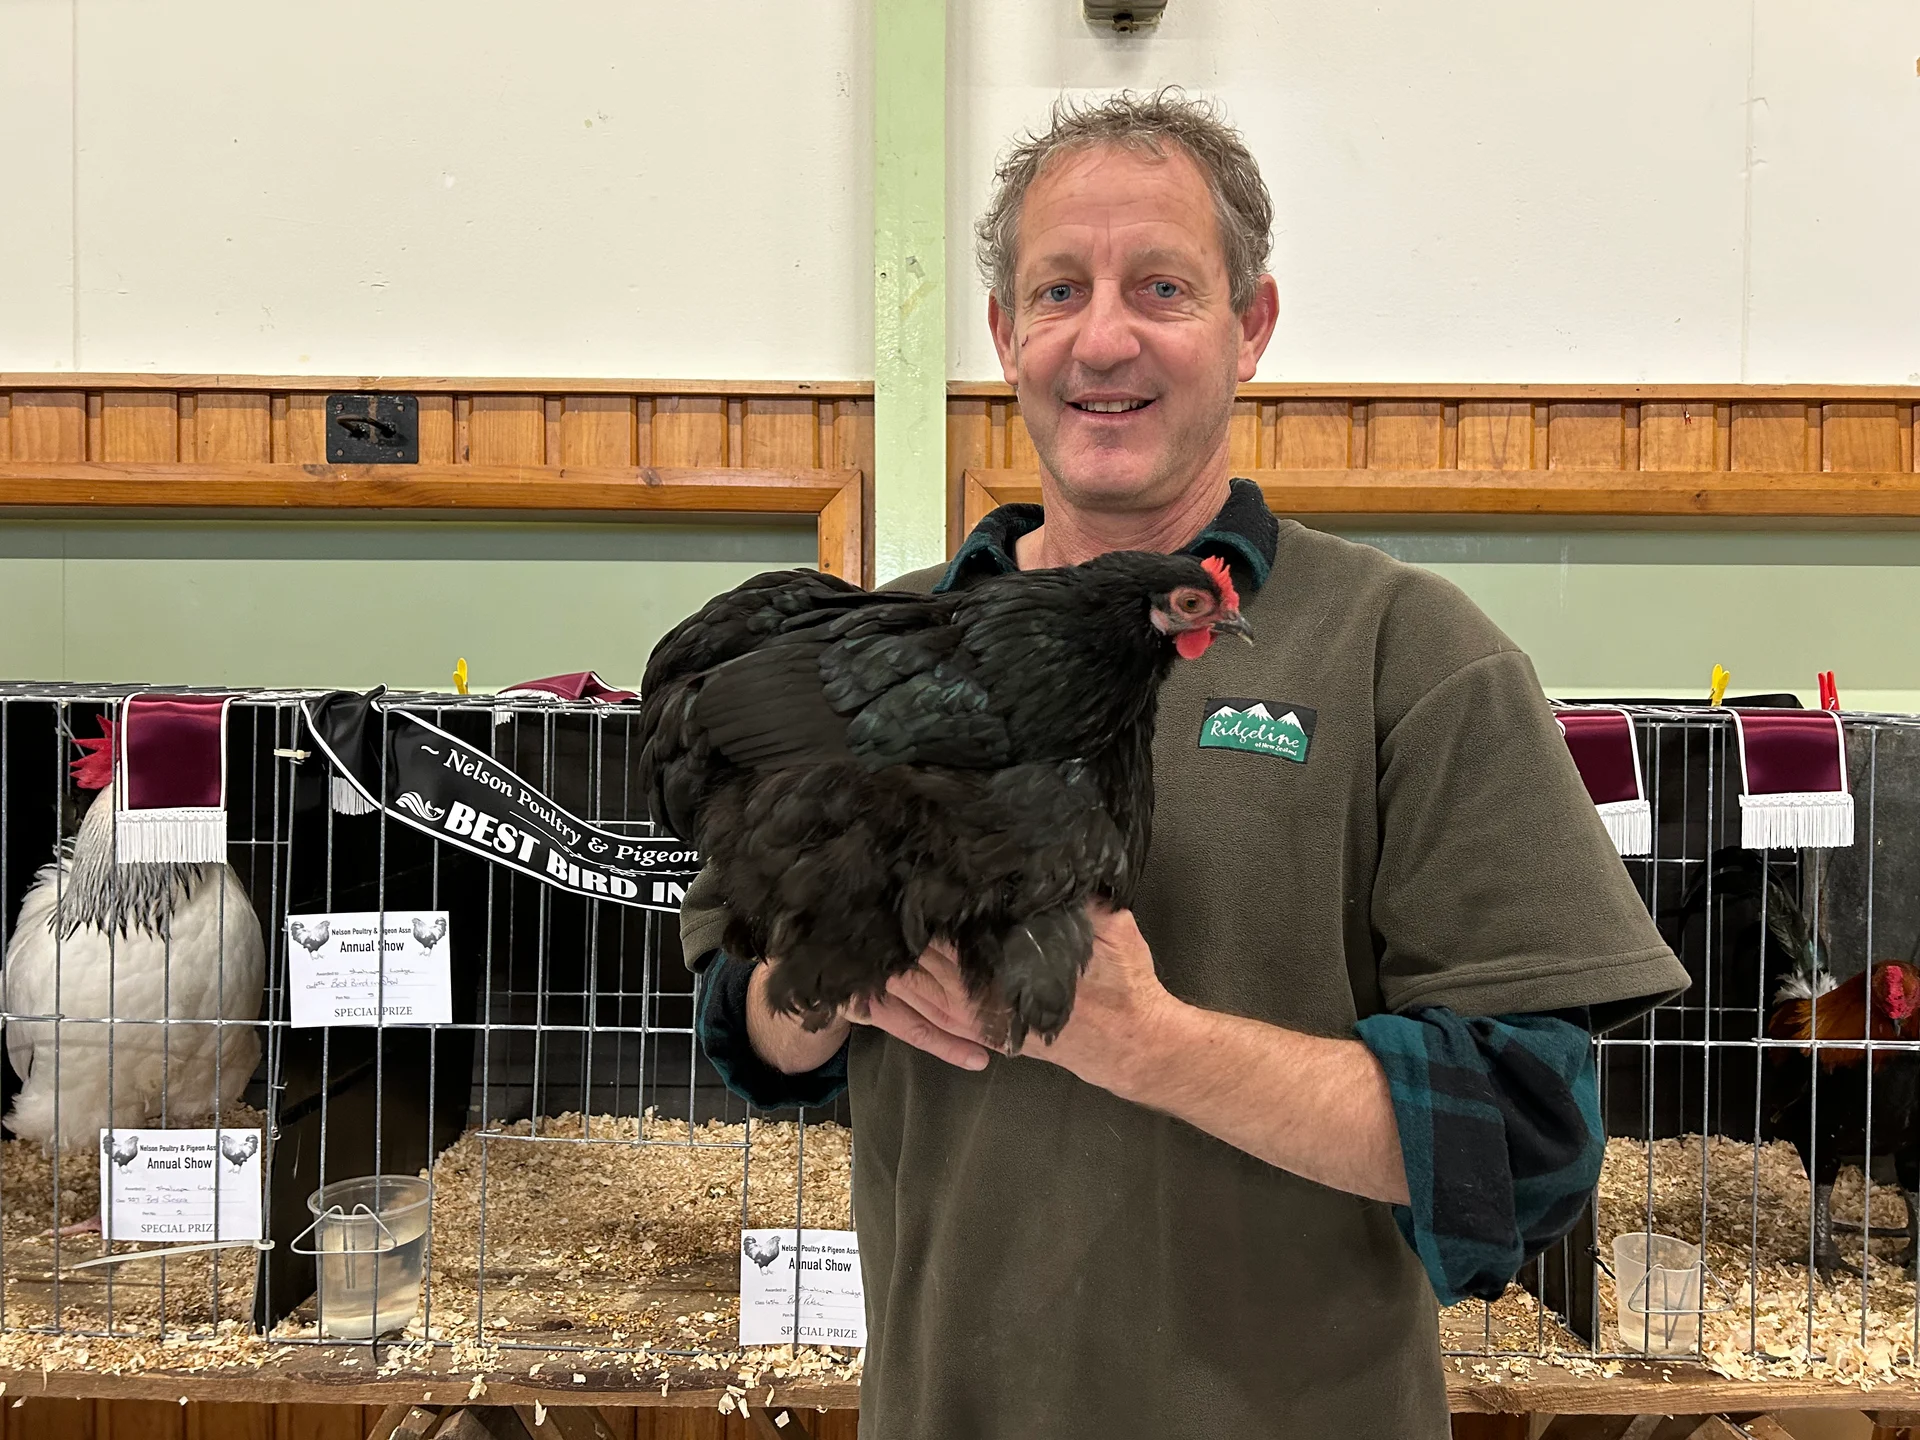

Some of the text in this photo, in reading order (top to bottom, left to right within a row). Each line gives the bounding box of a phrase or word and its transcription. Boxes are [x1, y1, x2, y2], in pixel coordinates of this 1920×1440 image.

[1210, 720, 1300, 748] Ridgeline
[443, 748, 699, 867] Nelson Poultry & Pigeon
[444, 800, 541, 864] BEST
[546, 848, 638, 899] BIRD
[331, 928, 351, 936] Nelson
[352, 927, 372, 936] Poultry
[373, 927, 378, 935] &
[398, 926, 412, 934] Assn
[340, 940, 375, 953] Annual
[334, 1006, 413, 1018] SPECIAL PRIZE
[140, 1144, 159, 1152] Nelson
[159, 1144, 179, 1153] Poultry
[180, 1144, 185, 1152] &
[186, 1144, 206, 1153] Pigeon
[147, 1157, 212, 1170] Annual Show
[141, 1223, 219, 1234] SPECIAL PRIZ
[781, 1244, 799, 1252] Nelso
[801, 1244, 821, 1254] Poultry
[821, 1245, 827, 1253] &
[827, 1246, 846, 1255] Pigeon
[825, 1258, 852, 1272] Show
[827, 1328, 858, 1339] PRIZE
